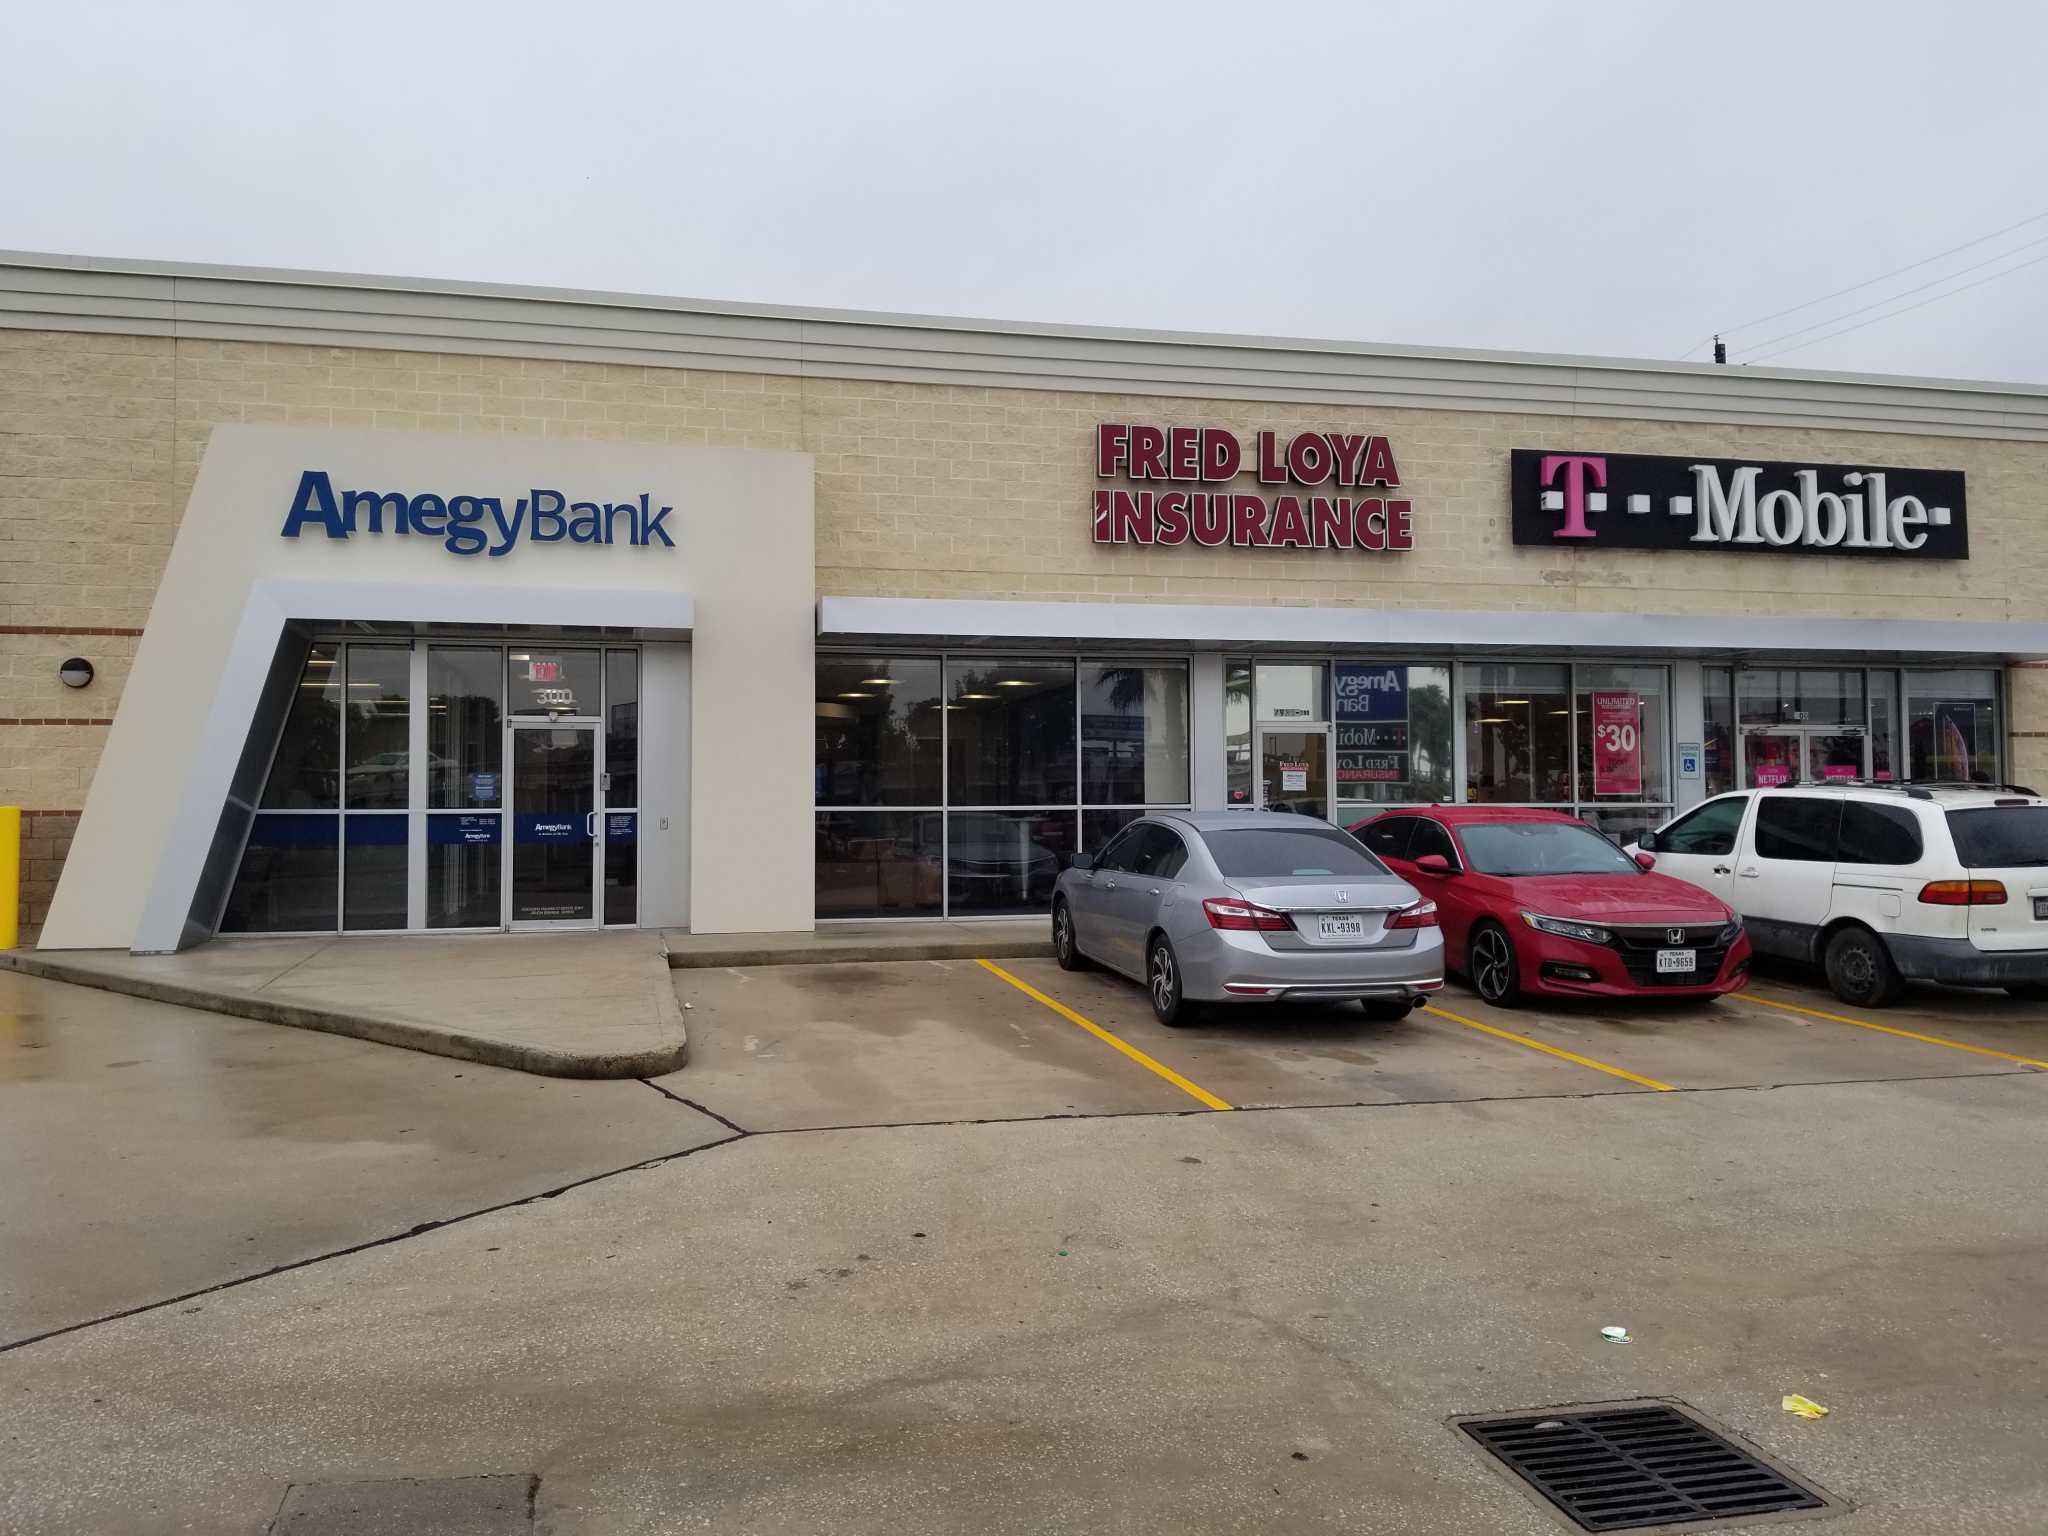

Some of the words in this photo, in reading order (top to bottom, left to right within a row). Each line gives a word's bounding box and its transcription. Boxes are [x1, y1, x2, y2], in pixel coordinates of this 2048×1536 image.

[1096, 424, 1241, 482] FRED
[1256, 431, 1401, 487] LOYA
[280, 470, 676, 557] AmegyBank
[1093, 489, 1415, 551] INSURANCE
[1597, 724, 1636, 752] $30
[1758, 775, 1787, 784] NETFLIX
